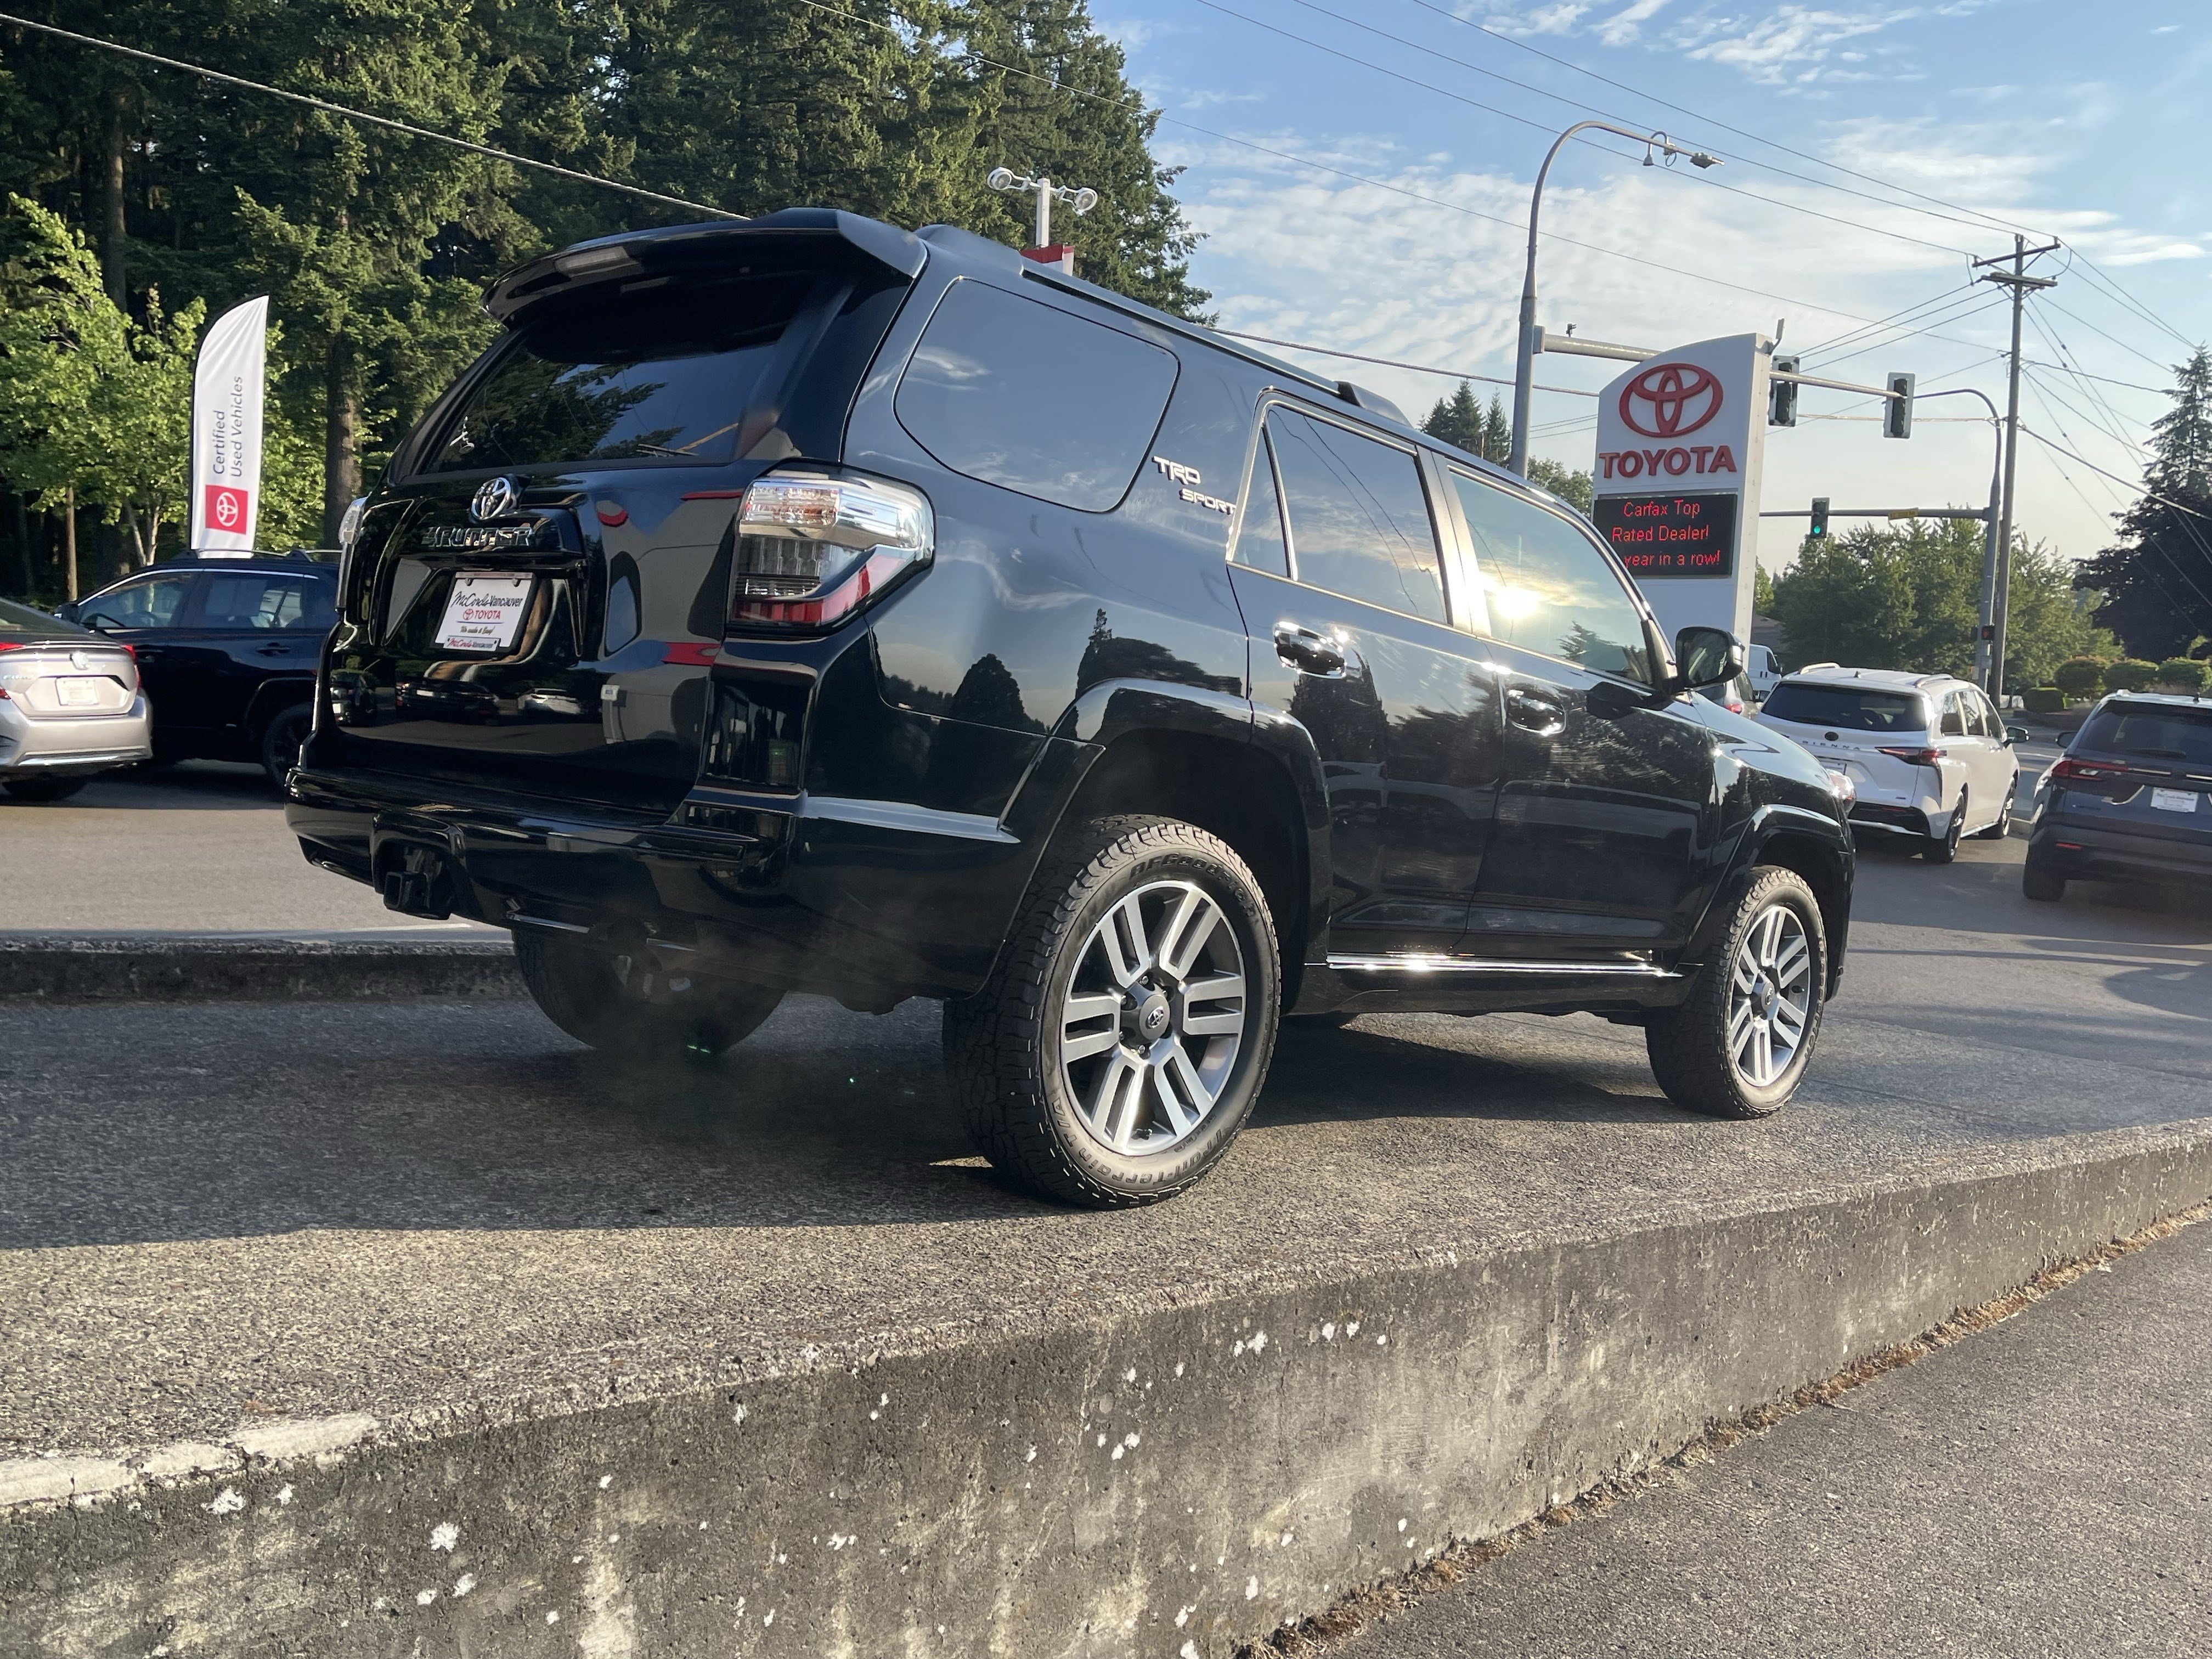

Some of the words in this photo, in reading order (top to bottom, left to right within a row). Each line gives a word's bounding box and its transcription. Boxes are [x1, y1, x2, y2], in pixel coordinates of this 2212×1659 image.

[230, 376, 242, 436] Vehicles
[213, 410, 225, 474] Certified
[230, 441, 242, 477] Used
[1152, 455, 1201, 485] TRD
[1599, 445, 1737, 478] TOYOTA
[1179, 488, 1237, 515] SPORT
[1623, 500, 1668, 517] Carfax
[1674, 498, 1701, 518] Top
[1612, 526, 1654, 543] Rated
[1658, 524, 1709, 542] Dealer!
[1623, 554, 1655, 569] year
[1658, 551, 1671, 566] in
[1677, 554, 1686, 566] a
[1690, 549, 1720, 566] row!
[490, 595, 523, 607] Vancouver
[475, 610, 501, 620] TOYOTA
